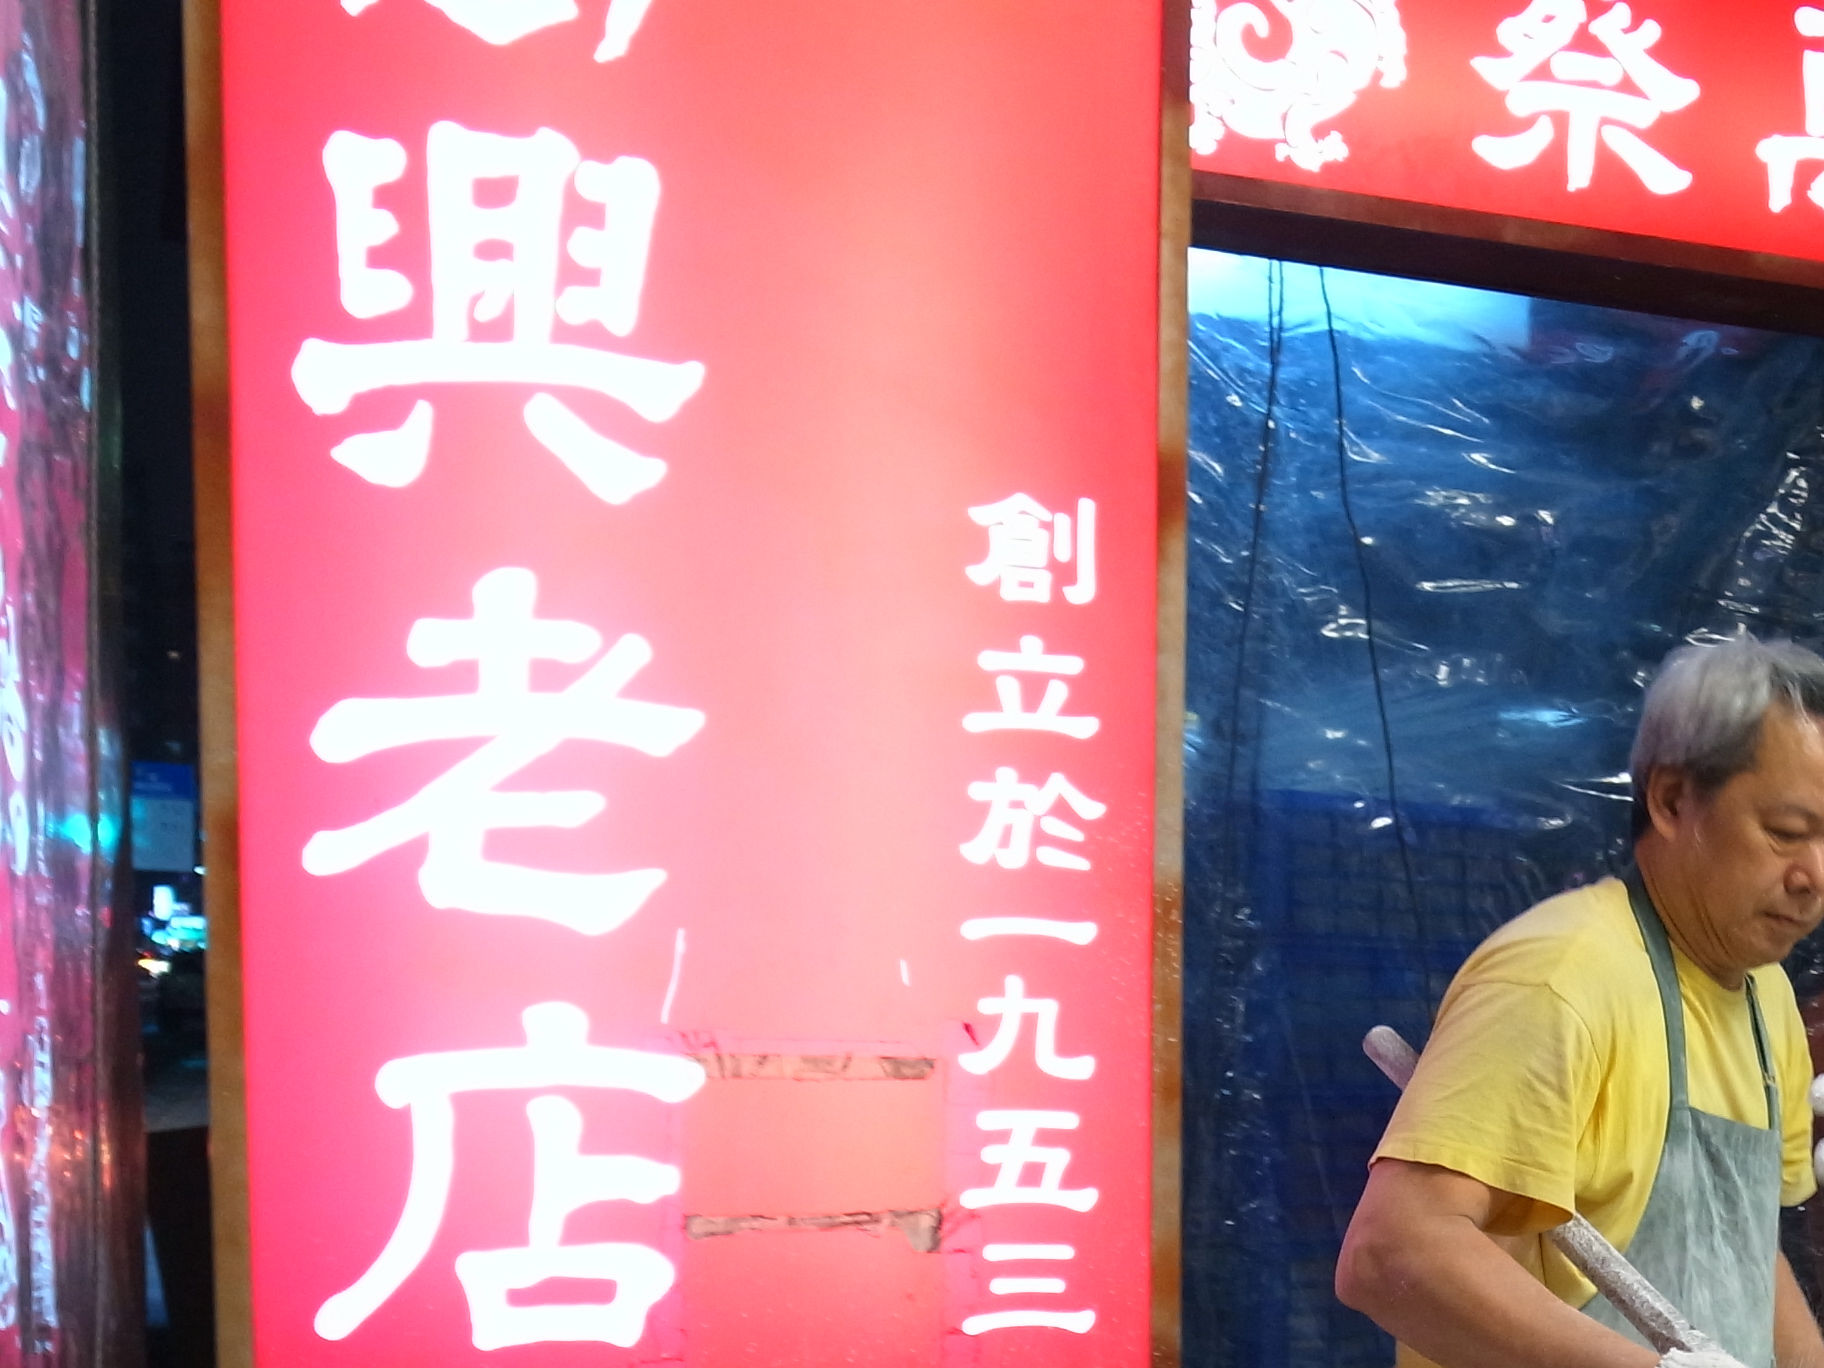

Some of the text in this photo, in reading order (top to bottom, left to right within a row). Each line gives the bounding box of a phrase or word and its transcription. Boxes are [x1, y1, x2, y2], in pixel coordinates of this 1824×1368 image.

[291, 0, 707, 1351] 興老店
[959, 491, 1106, 1336] 創立於一九五三
